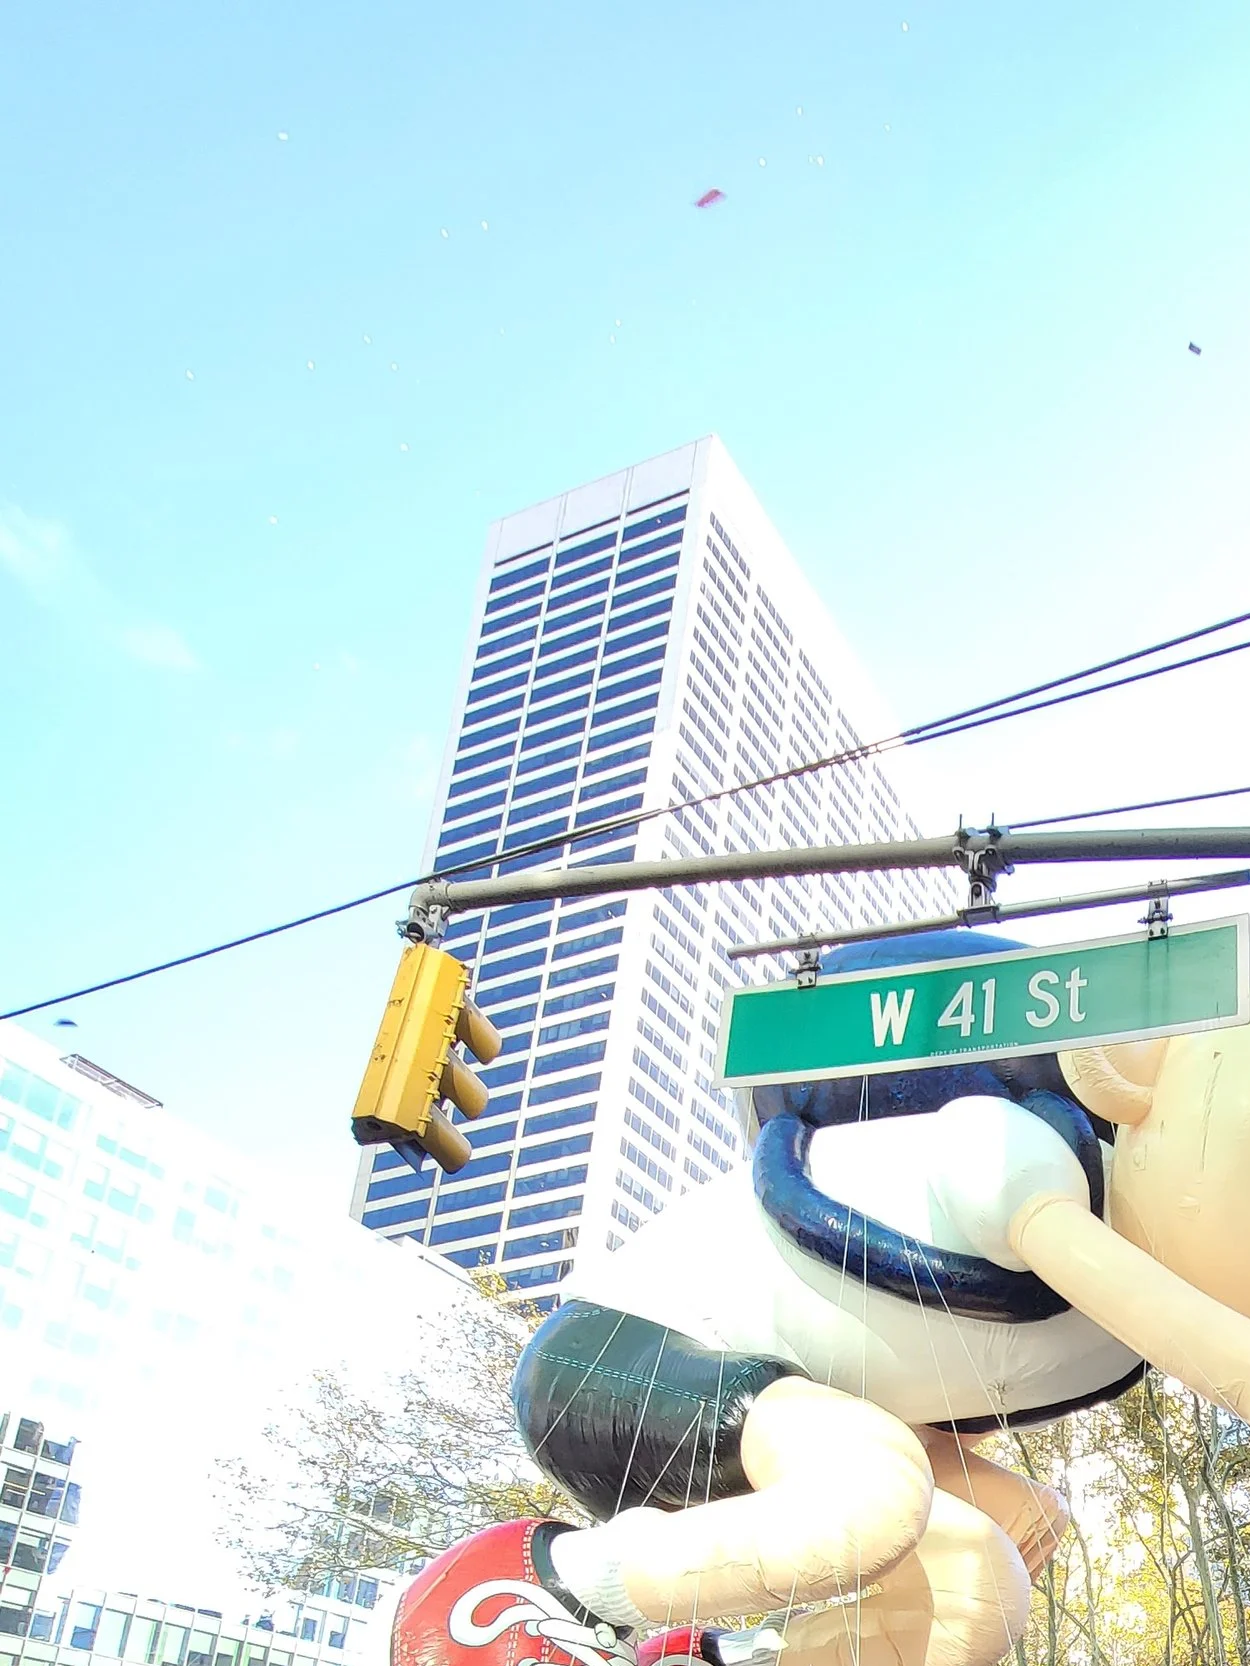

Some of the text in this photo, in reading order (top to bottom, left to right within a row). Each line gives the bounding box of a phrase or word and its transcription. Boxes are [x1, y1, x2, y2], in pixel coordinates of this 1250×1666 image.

[869, 966, 1089, 1048] W 41 St
[959, 1042, 1019, 1053] TRANSPORTATION
